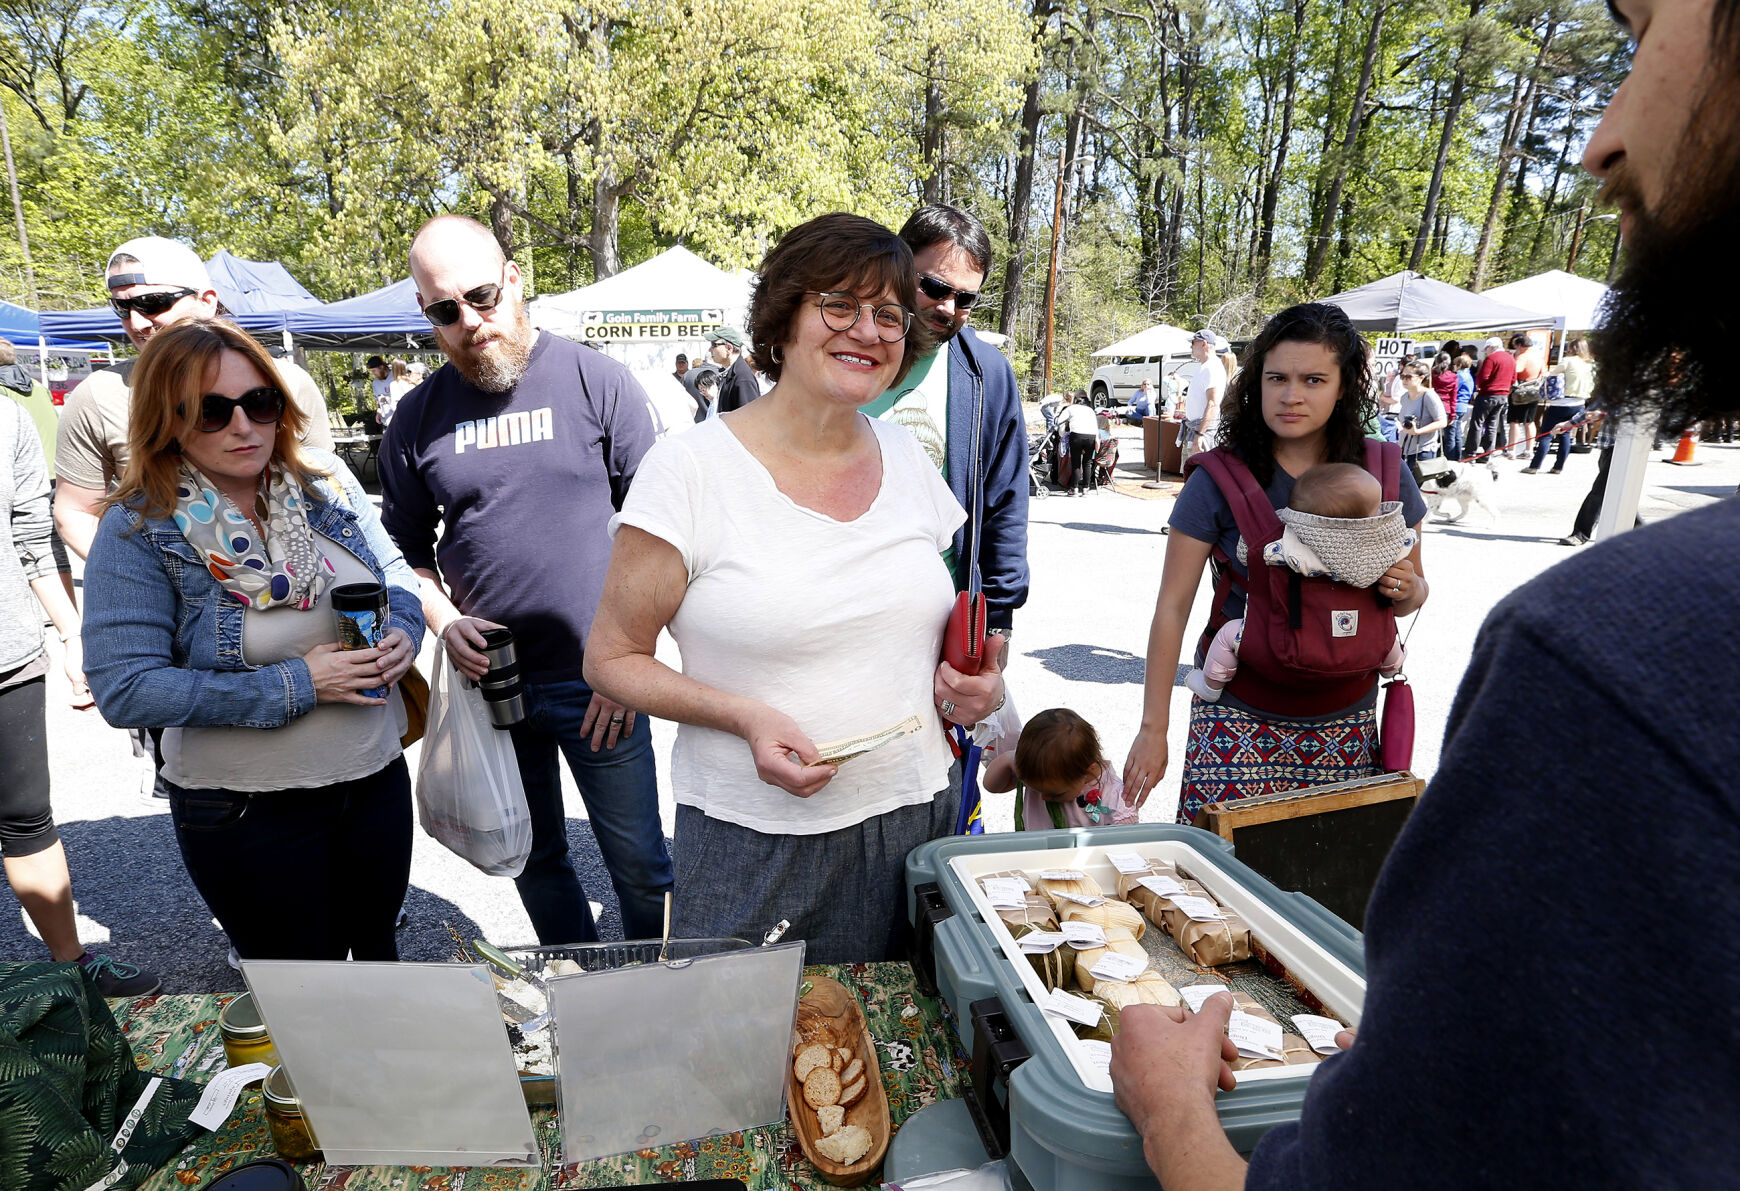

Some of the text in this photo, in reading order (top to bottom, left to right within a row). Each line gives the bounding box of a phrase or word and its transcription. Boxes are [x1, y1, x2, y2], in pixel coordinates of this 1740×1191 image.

[606, 312, 699, 325] Goin Family Farm
[585, 326, 632, 339] CORN
[639, 325, 671, 338] FED
[1378, 340, 1411, 355] HOT
[454, 407, 554, 454] PUMA
